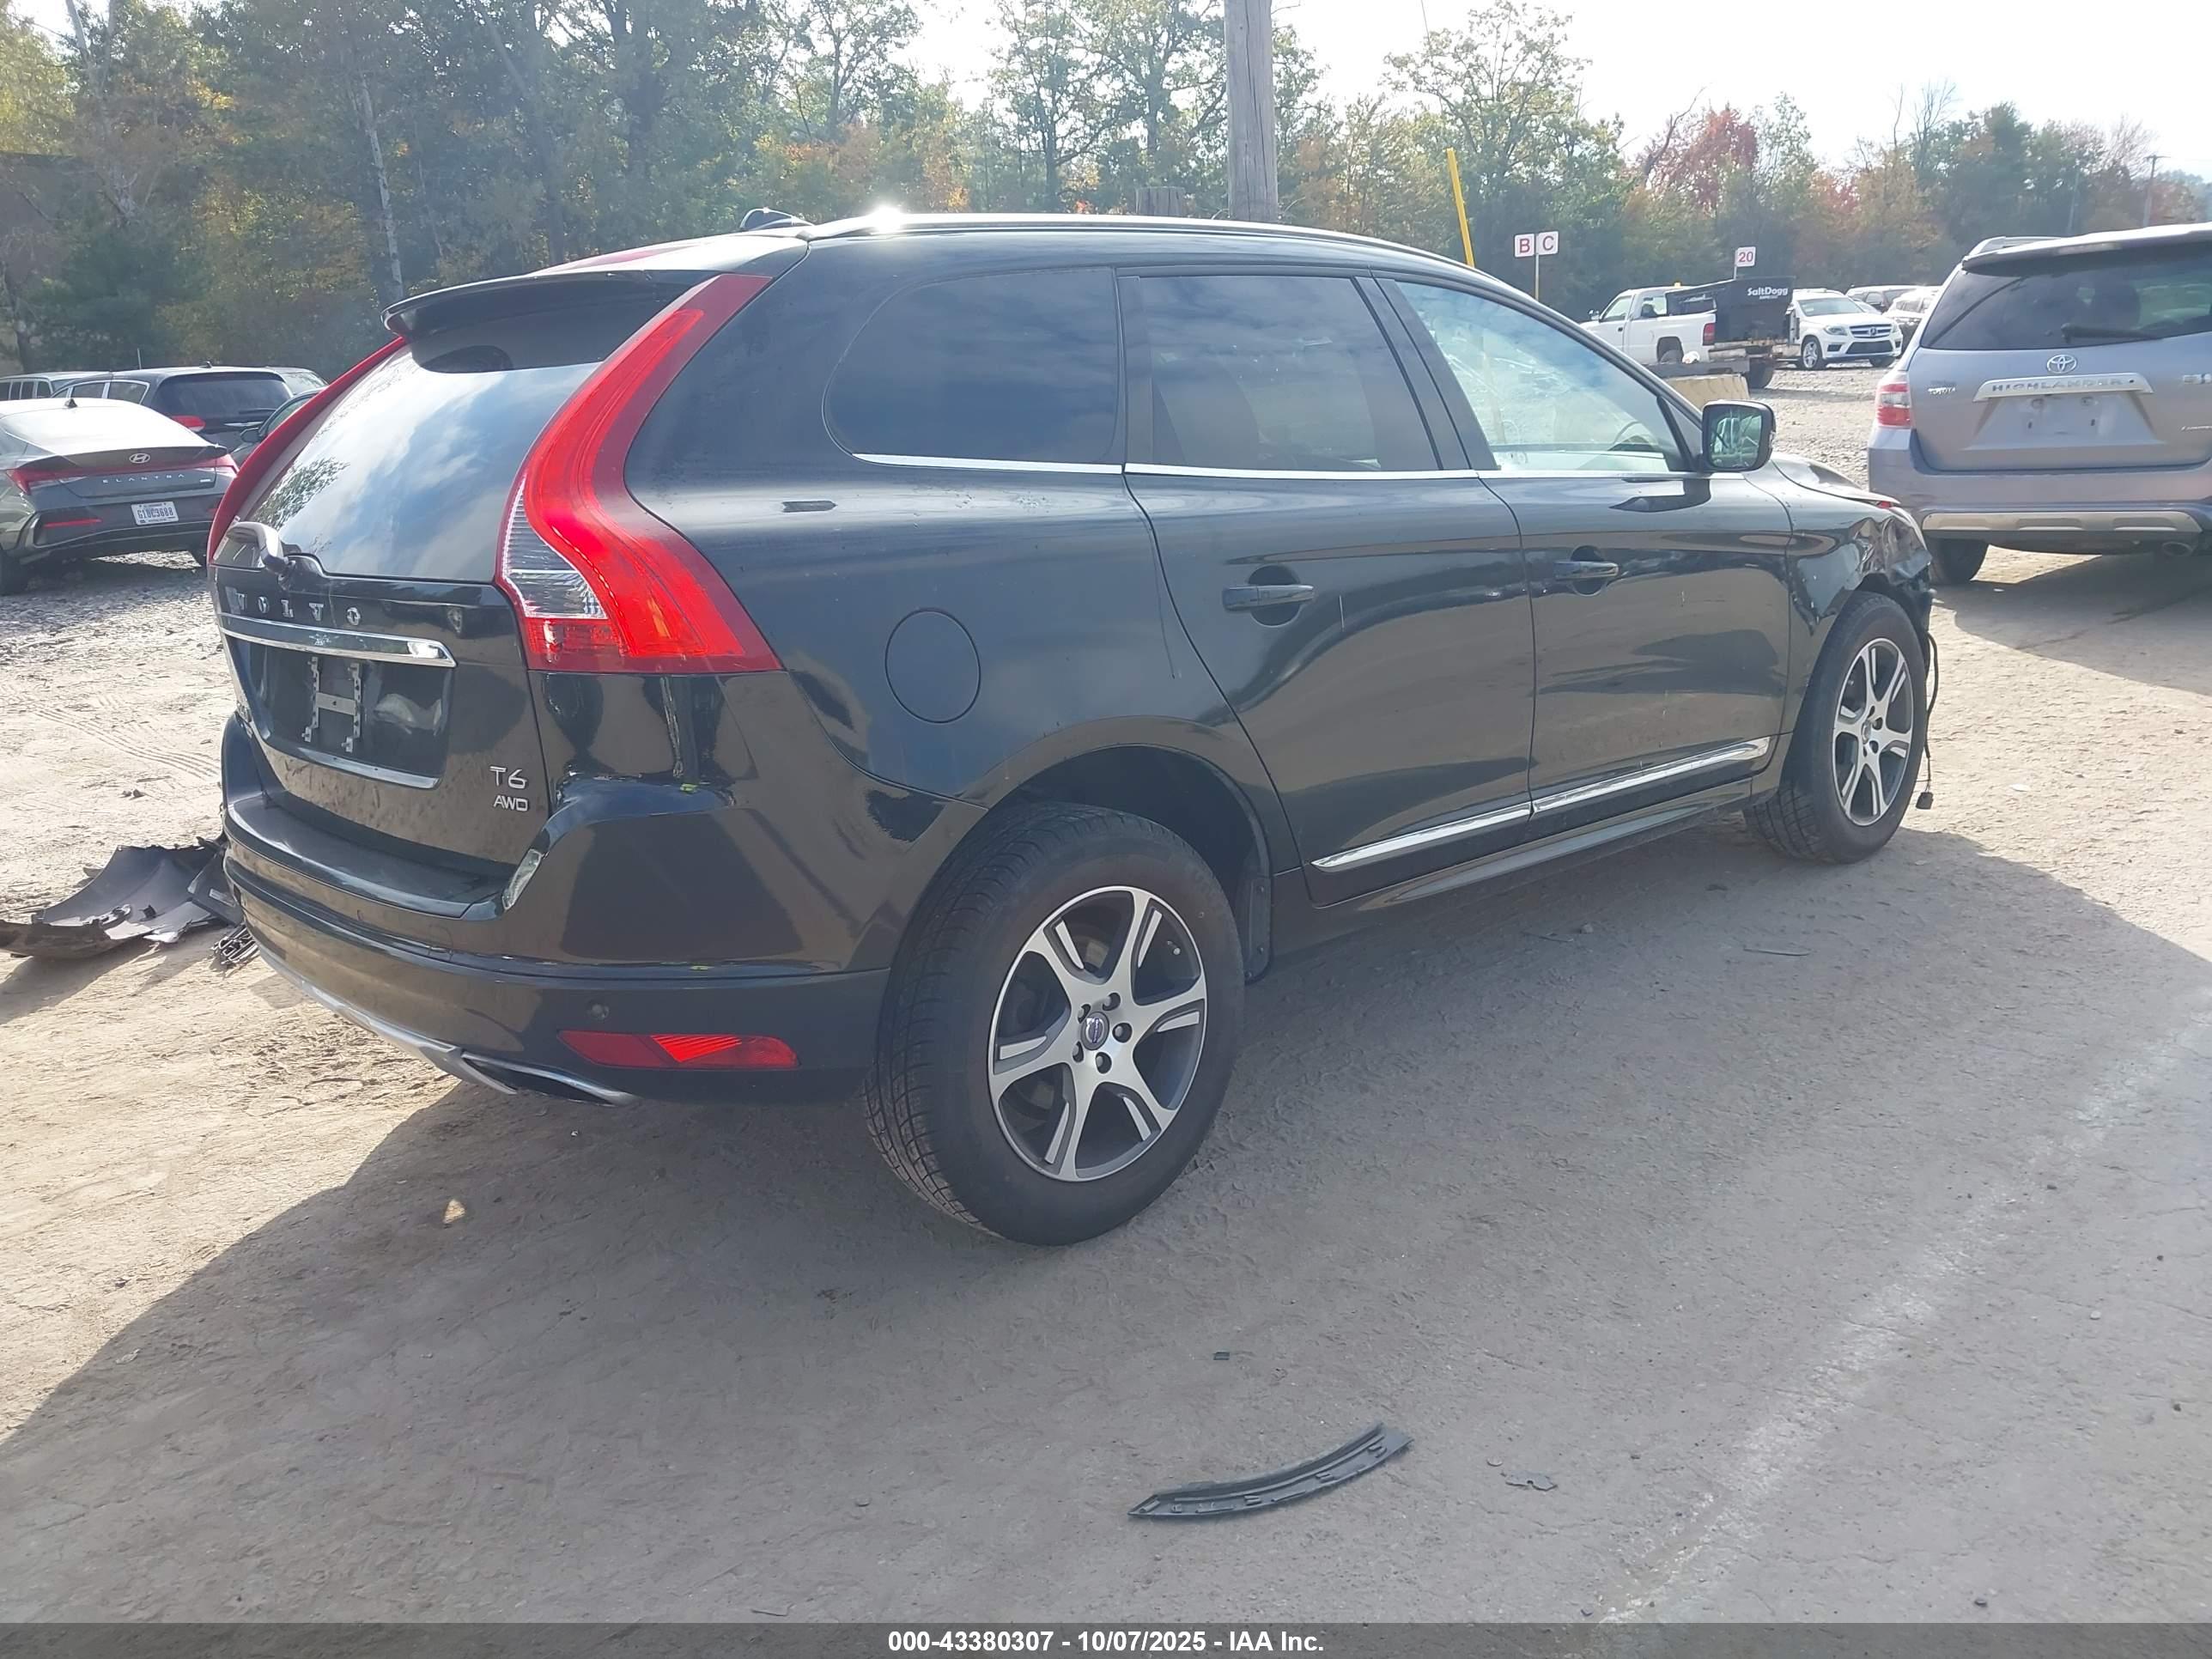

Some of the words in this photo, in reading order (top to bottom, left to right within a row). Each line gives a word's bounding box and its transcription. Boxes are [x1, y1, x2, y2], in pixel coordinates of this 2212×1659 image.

[1519, 238, 1530, 253] B
[1542, 235, 1554, 251] C
[1738, 251, 1753, 263] 20
[1992, 379, 2123, 392] HIGHLANDER
[102, 473, 185, 483] ELANTRA
[234, 592, 362, 626] VOLVO
[489, 765, 527, 789] T6
[493, 794, 528, 811] AWD
